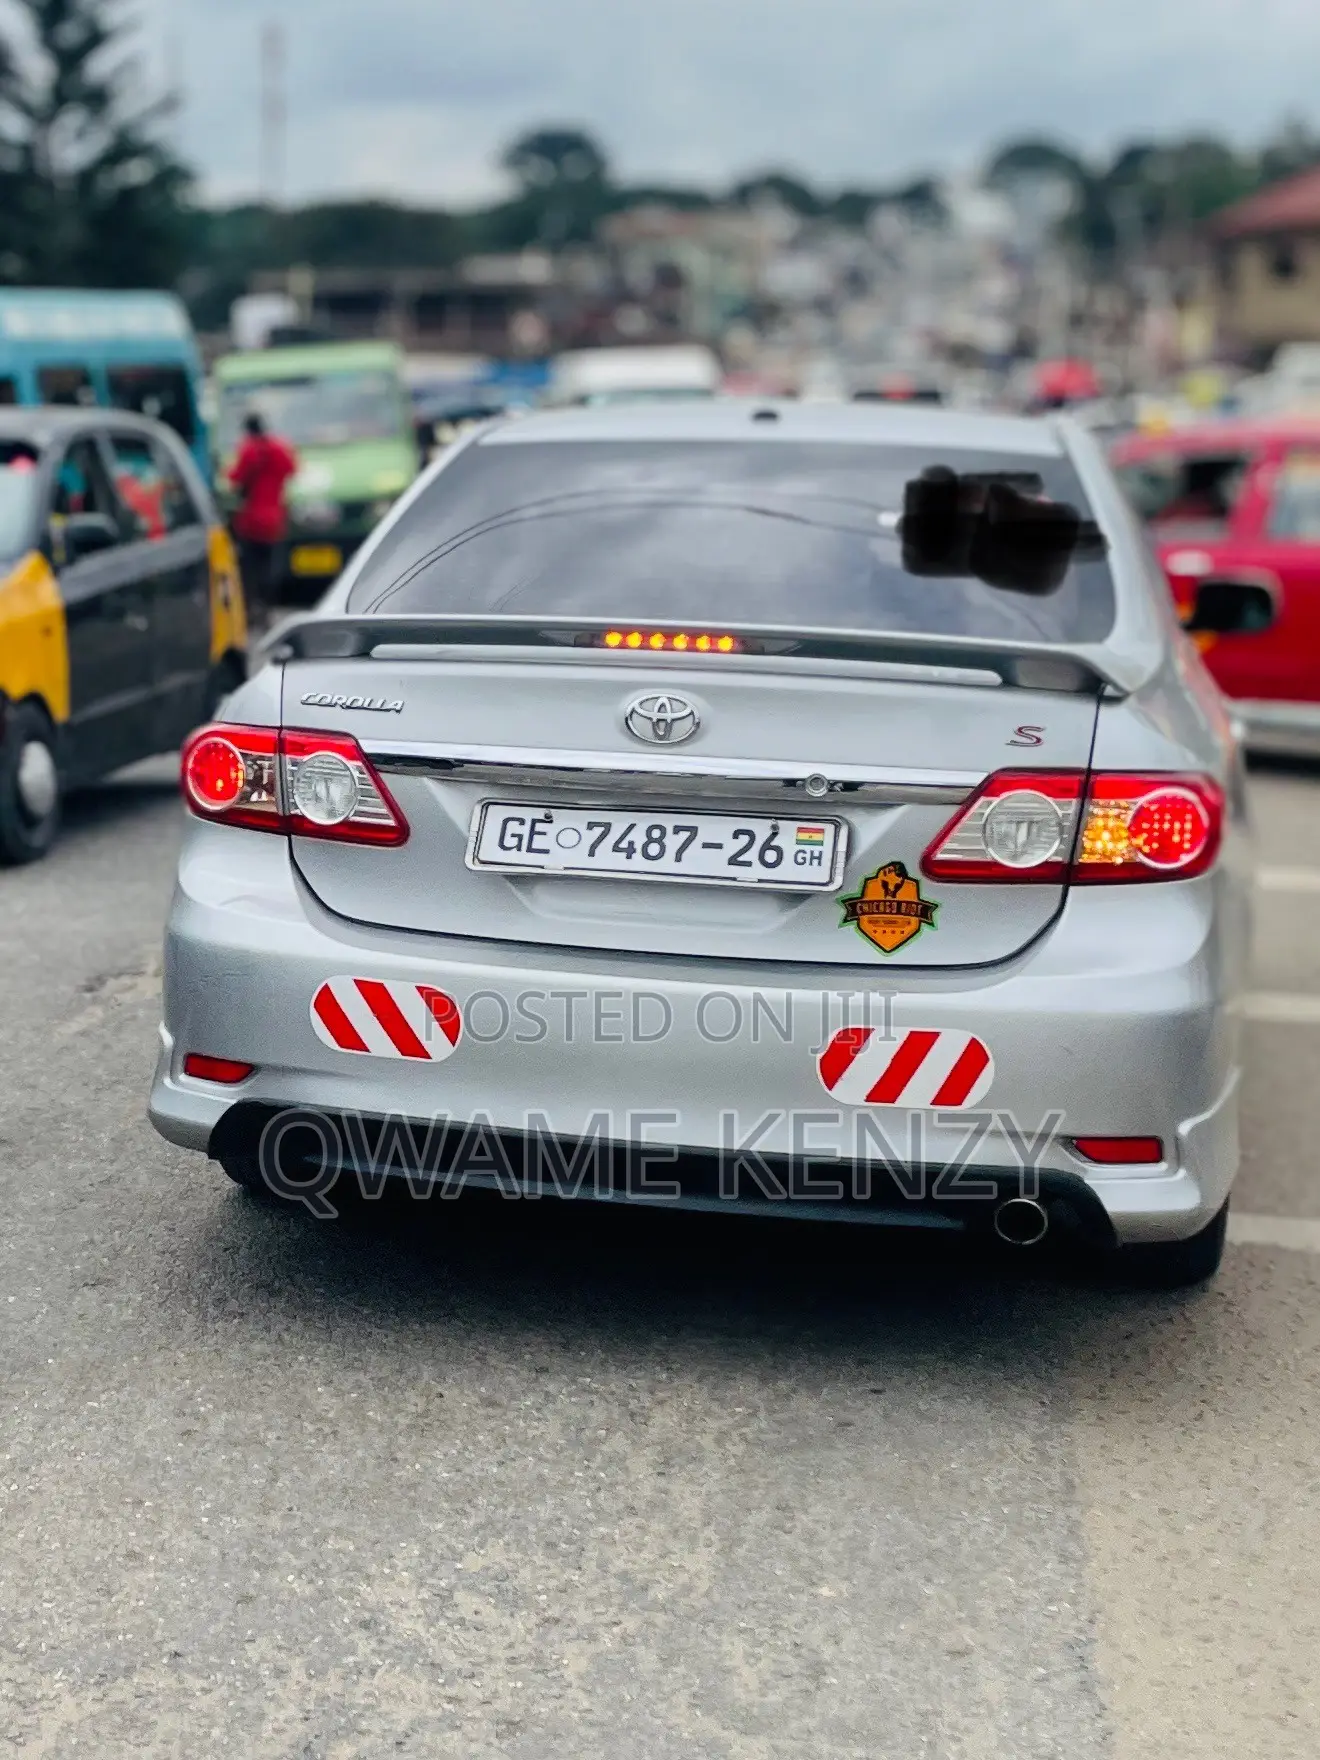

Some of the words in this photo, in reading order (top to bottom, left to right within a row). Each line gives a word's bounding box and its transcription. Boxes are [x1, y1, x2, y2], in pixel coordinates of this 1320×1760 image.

[301, 692, 404, 714] COROLLA
[1005, 725, 1045, 747] S
[498, 816, 553, 854] GE
[586, 821, 784, 869] 7487-26
[793, 848, 823, 867] GH
